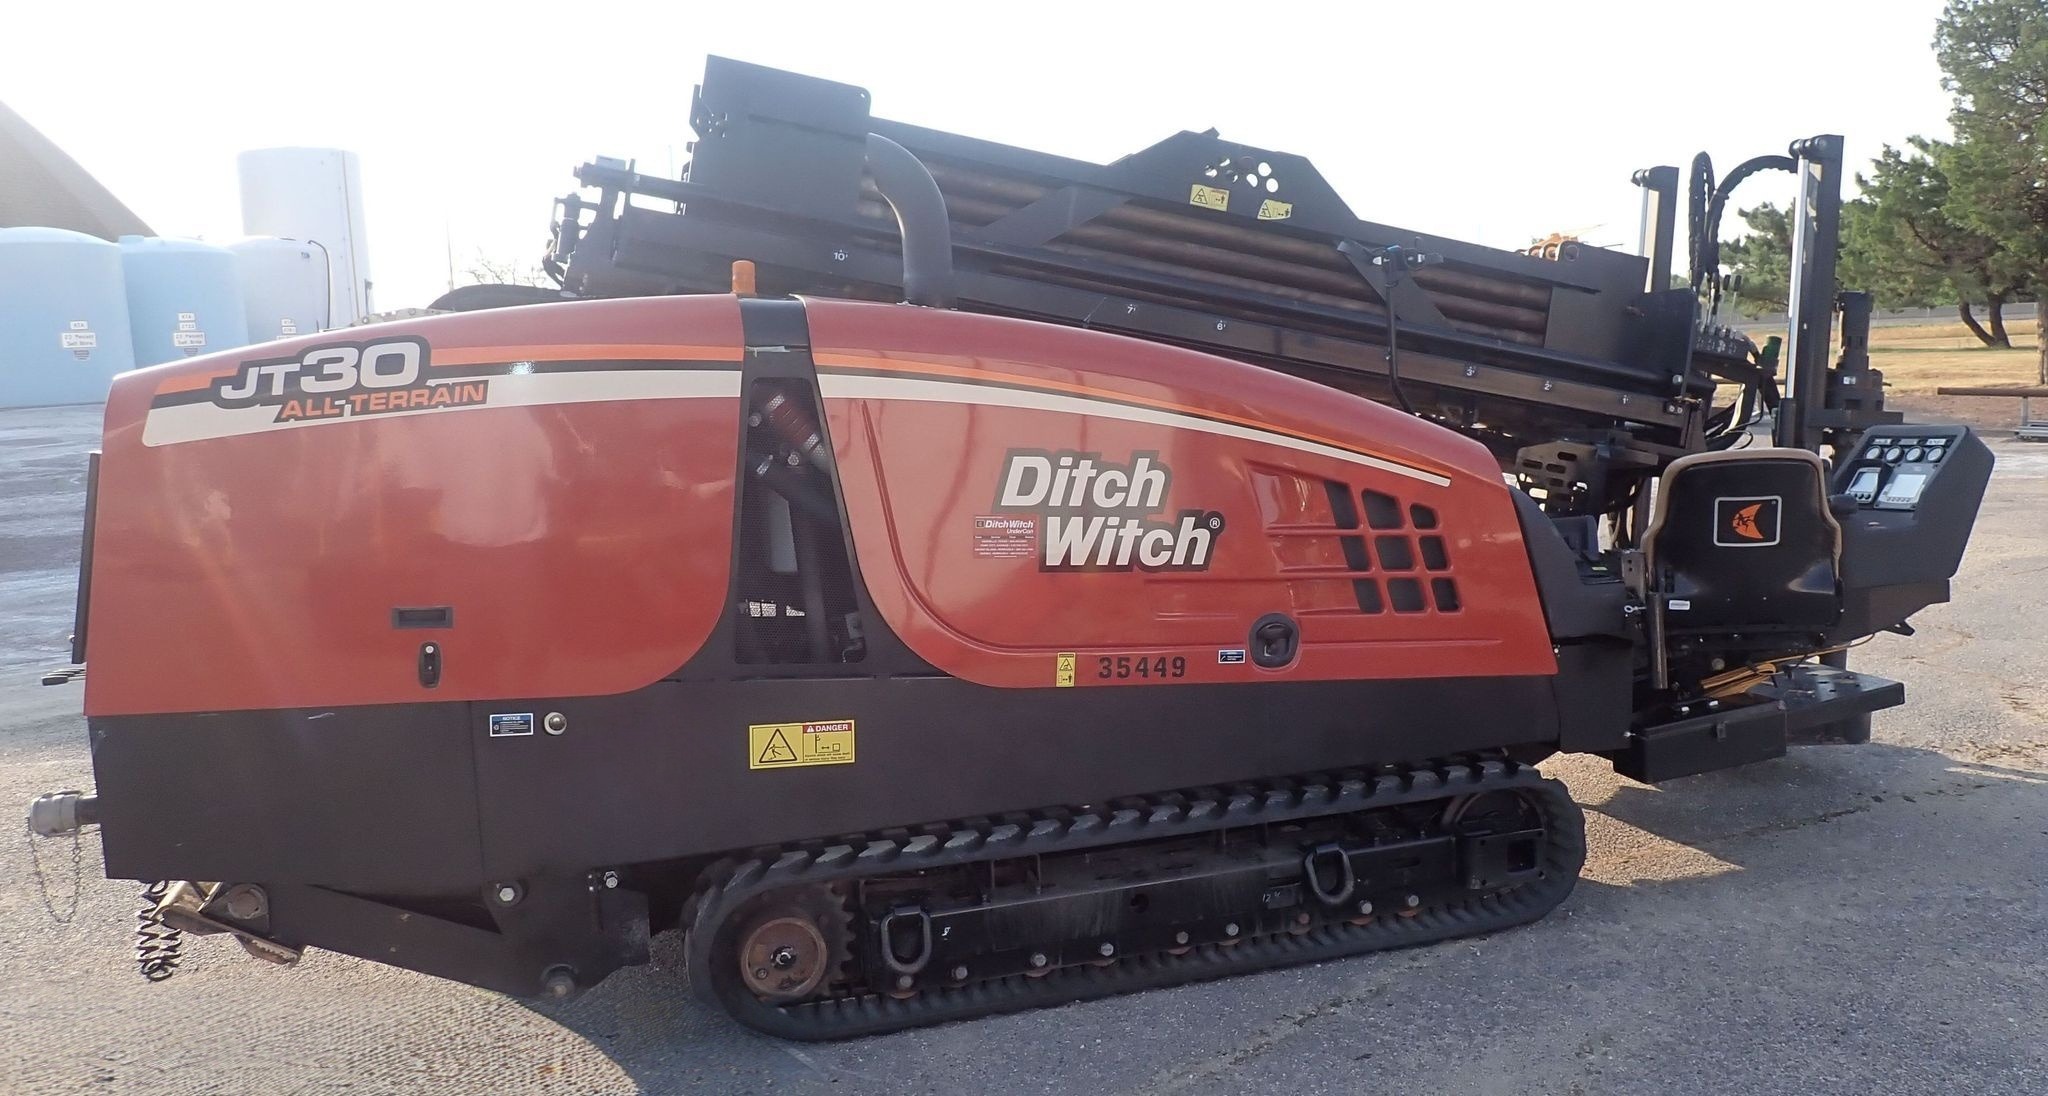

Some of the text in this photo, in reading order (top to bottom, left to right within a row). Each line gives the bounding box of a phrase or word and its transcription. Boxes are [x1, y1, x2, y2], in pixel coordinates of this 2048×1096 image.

[220, 342, 420, 399] JT30
[349, 384, 484, 412] TERRAIN
[1001, 456, 1166, 508] Ditch
[1098, 656, 1187, 679] 35449
[815, 723, 849, 732] DANGER
